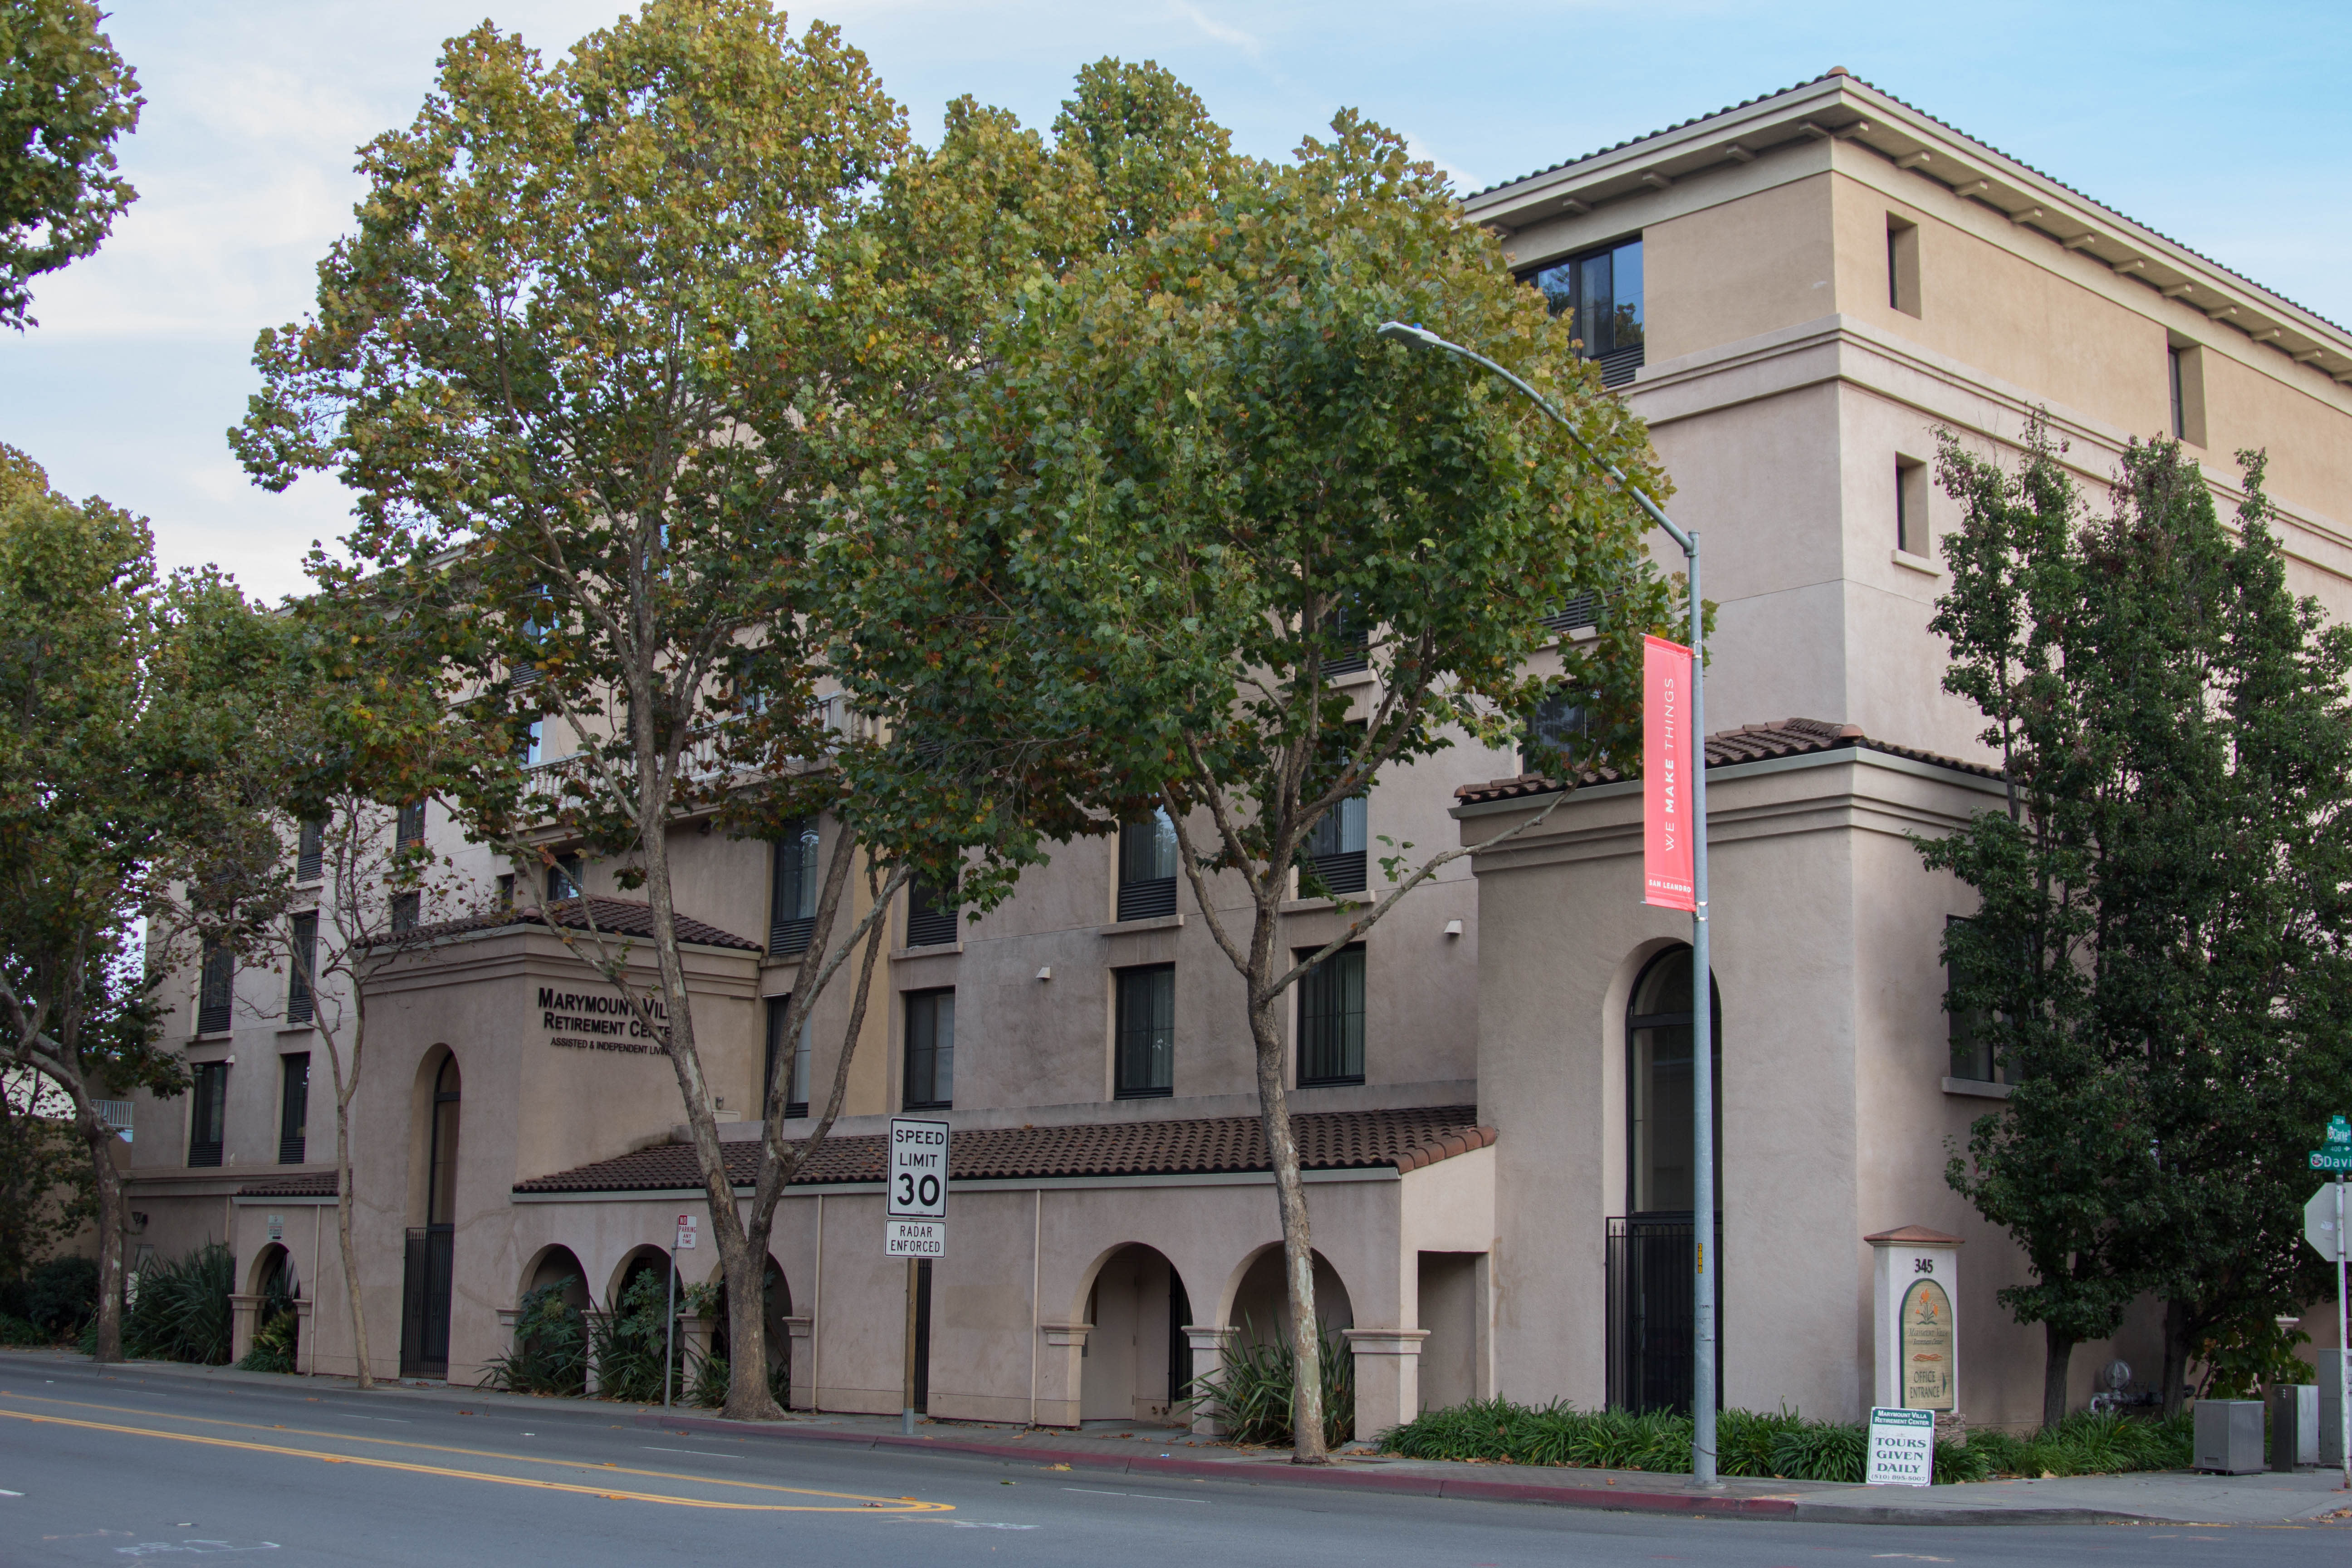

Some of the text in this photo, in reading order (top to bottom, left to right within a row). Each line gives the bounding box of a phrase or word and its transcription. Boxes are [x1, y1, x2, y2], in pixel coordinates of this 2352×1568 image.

[1665, 678, 1675, 851] WE MAKE THINGS
[1649, 879, 1691, 893] SAN LEANDRO
[539, 987, 668, 1019] MARYMOUN VIL
[544, 1011, 625, 1035] RETIREMENT
[550, 1037, 588, 1049] ASSISTED
[589, 1040, 595, 1049] &
[597, 1041, 648, 1054] INDEPENDENT
[896, 1129, 944, 1145] SPEED
[900, 1152, 938, 1167] LIMIT
[897, 1173, 940, 1206] 30
[680, 1216, 686, 1225] NO
[900, 1225, 932, 1238] RADAR
[891, 1240, 940, 1252] ENFORCED
[1915, 1258, 1934, 1274] 345
[1914, 1371, 1936, 1383] OFFICE
[1910, 1387, 1940, 1398] ENTRANCE
[1875, 1437, 1926, 1448] TOURS
[1877, 1450, 1923, 1460] GIVEN
[1877, 1463, 1921, 1473] DAILY
